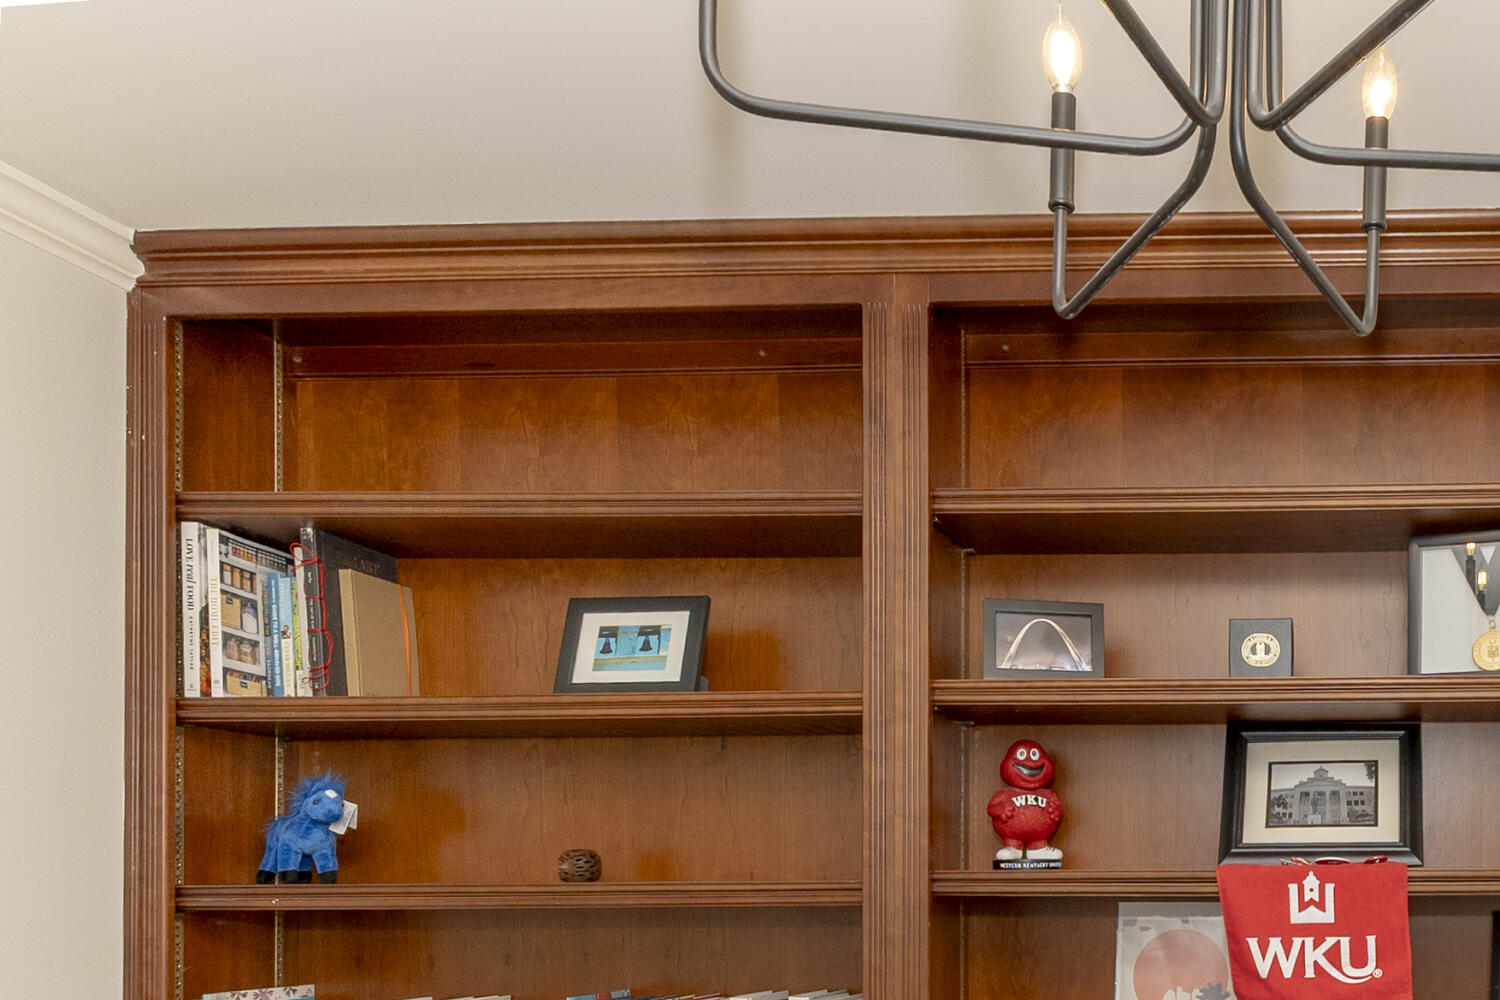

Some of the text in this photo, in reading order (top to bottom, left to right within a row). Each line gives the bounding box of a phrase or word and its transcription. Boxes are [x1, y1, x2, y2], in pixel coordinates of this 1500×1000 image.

[185, 538, 194, 562] LOVE
[186, 564, 196, 584] real
[209, 577, 218, 591] THE
[210, 597, 218, 622] HOME
[1011, 794, 1047, 808] WKU
[1245, 935, 1377, 984] WKU
